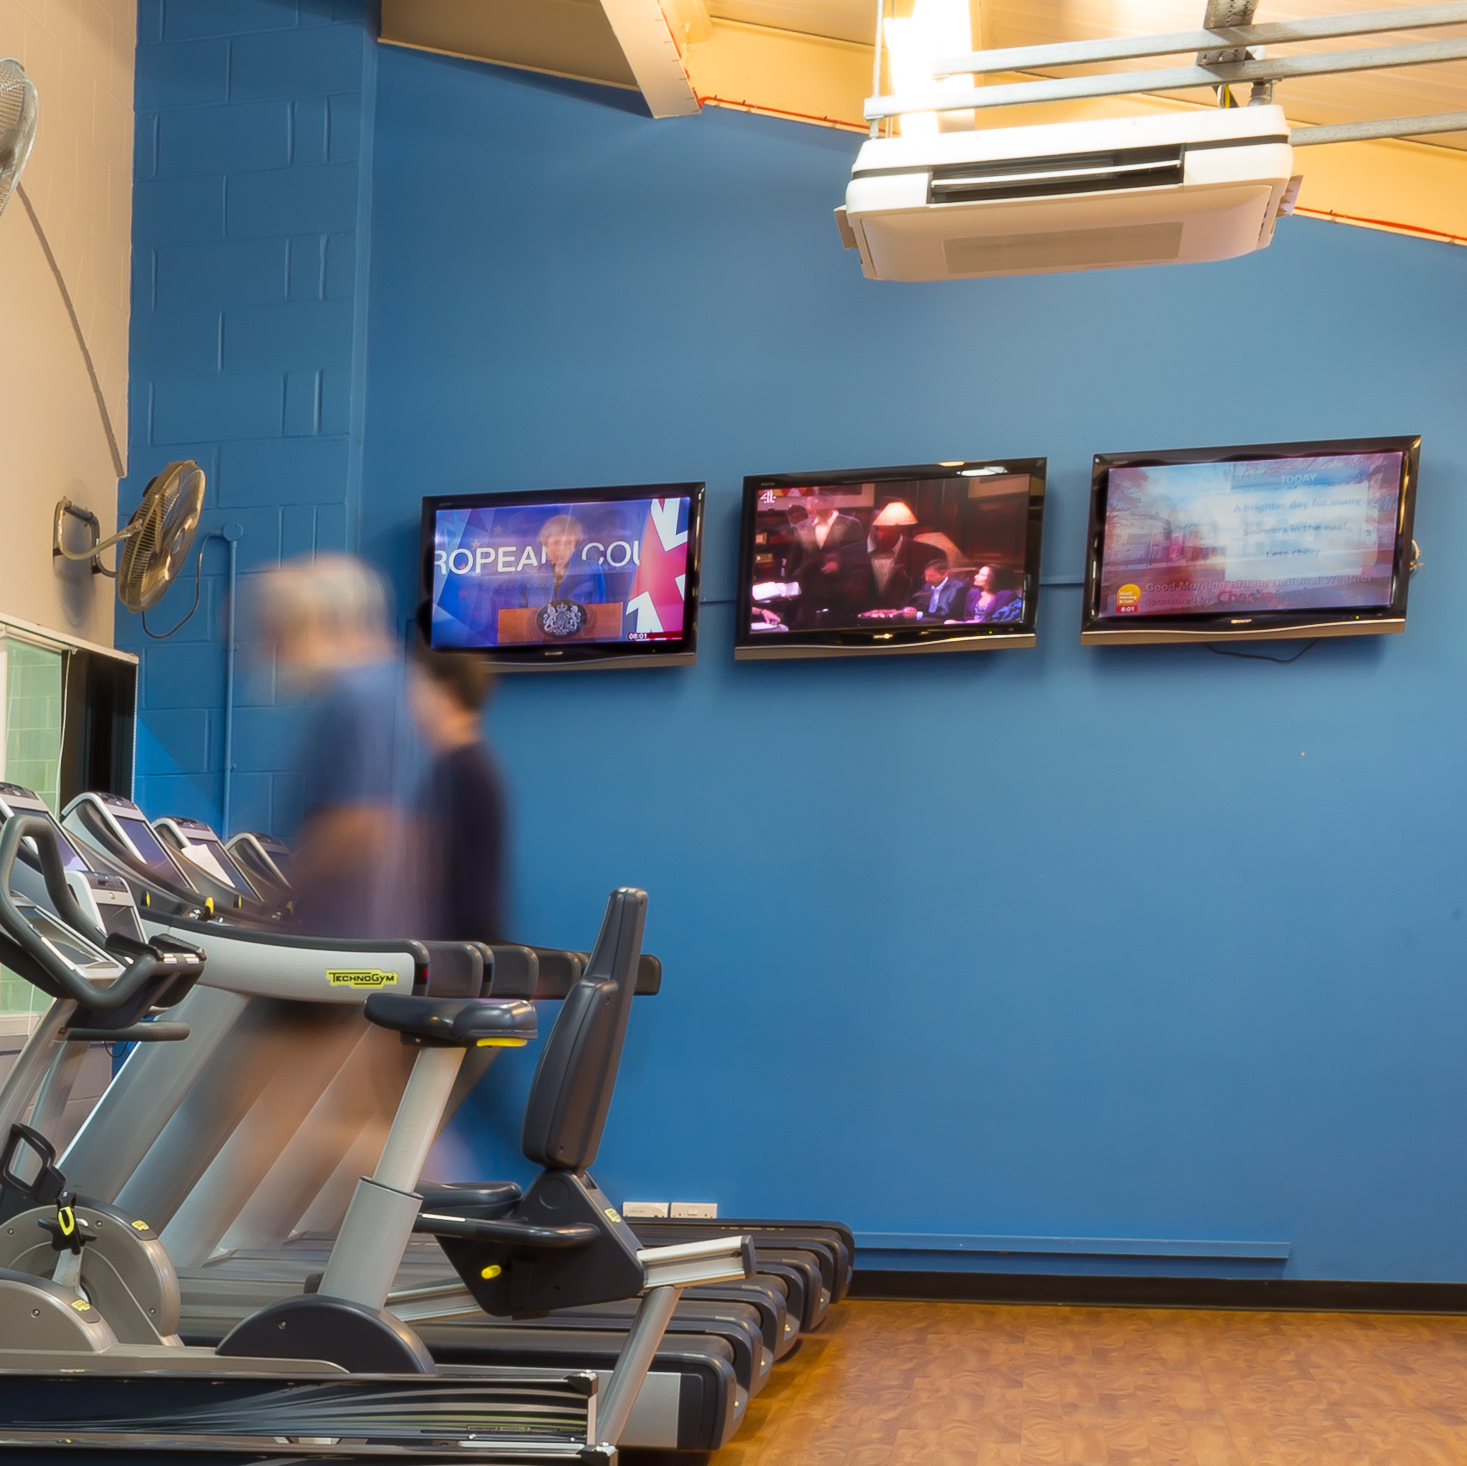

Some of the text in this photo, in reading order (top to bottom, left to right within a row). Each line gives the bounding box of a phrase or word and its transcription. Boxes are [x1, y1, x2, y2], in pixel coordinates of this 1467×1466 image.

[1280, 473, 1317, 485] TODAY
[1243, 502, 1286, 513] brighter
[1289, 500, 1308, 510] day
[1311, 498, 1328, 507] for
[1302, 523, 1321, 531] the
[1146, 581, 1176, 592] Good
[328, 971, 395, 985] TECHNOGYM
